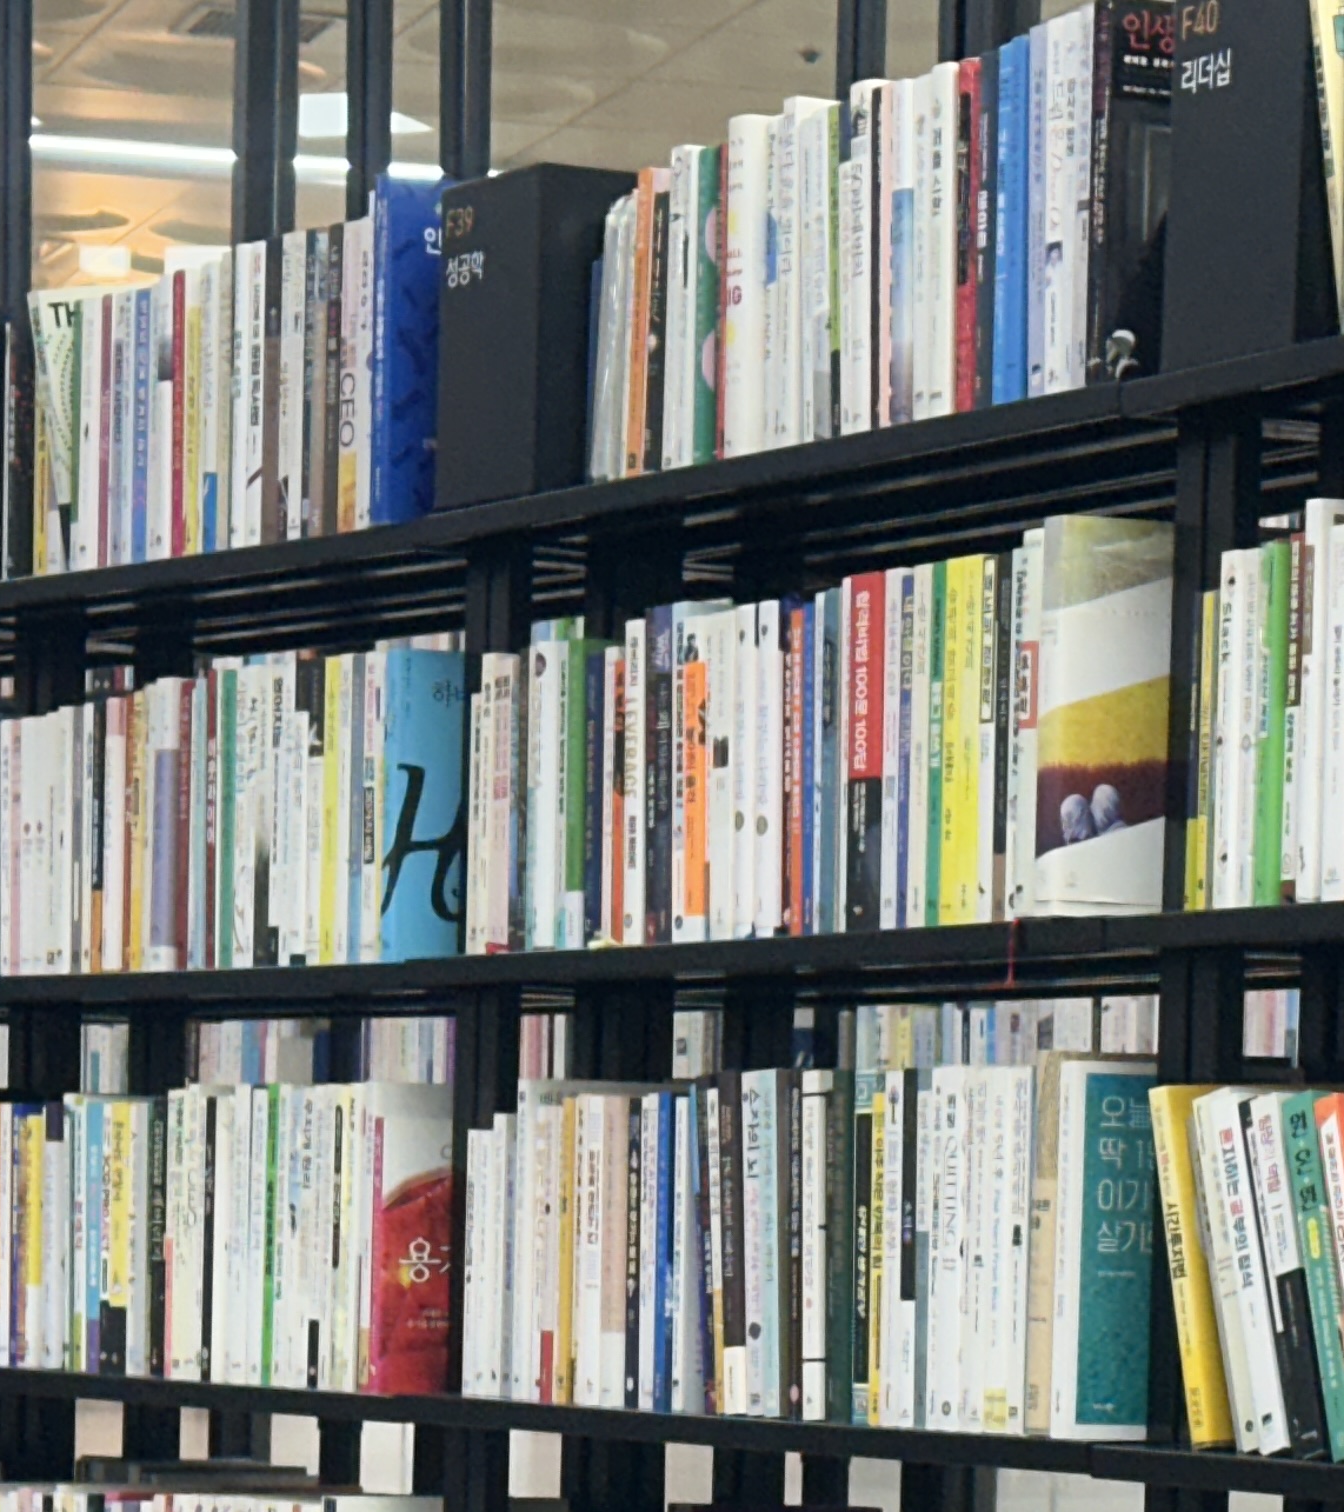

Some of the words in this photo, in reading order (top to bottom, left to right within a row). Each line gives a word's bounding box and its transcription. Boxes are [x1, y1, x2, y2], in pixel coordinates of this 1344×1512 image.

[1180, 1, 1220, 40] F40
[1179, 49, 1233, 94] 리더십
[444, 207, 475, 241] F39
[444, 251, 485, 289] 성공학
[1221, 602, 1232, 665] Slack
[624, 698, 639, 800] LEVERAGE
[943, 1136, 958, 1246] QUITTING
[1166, 1203, 1187, 1278] 시간투자법
